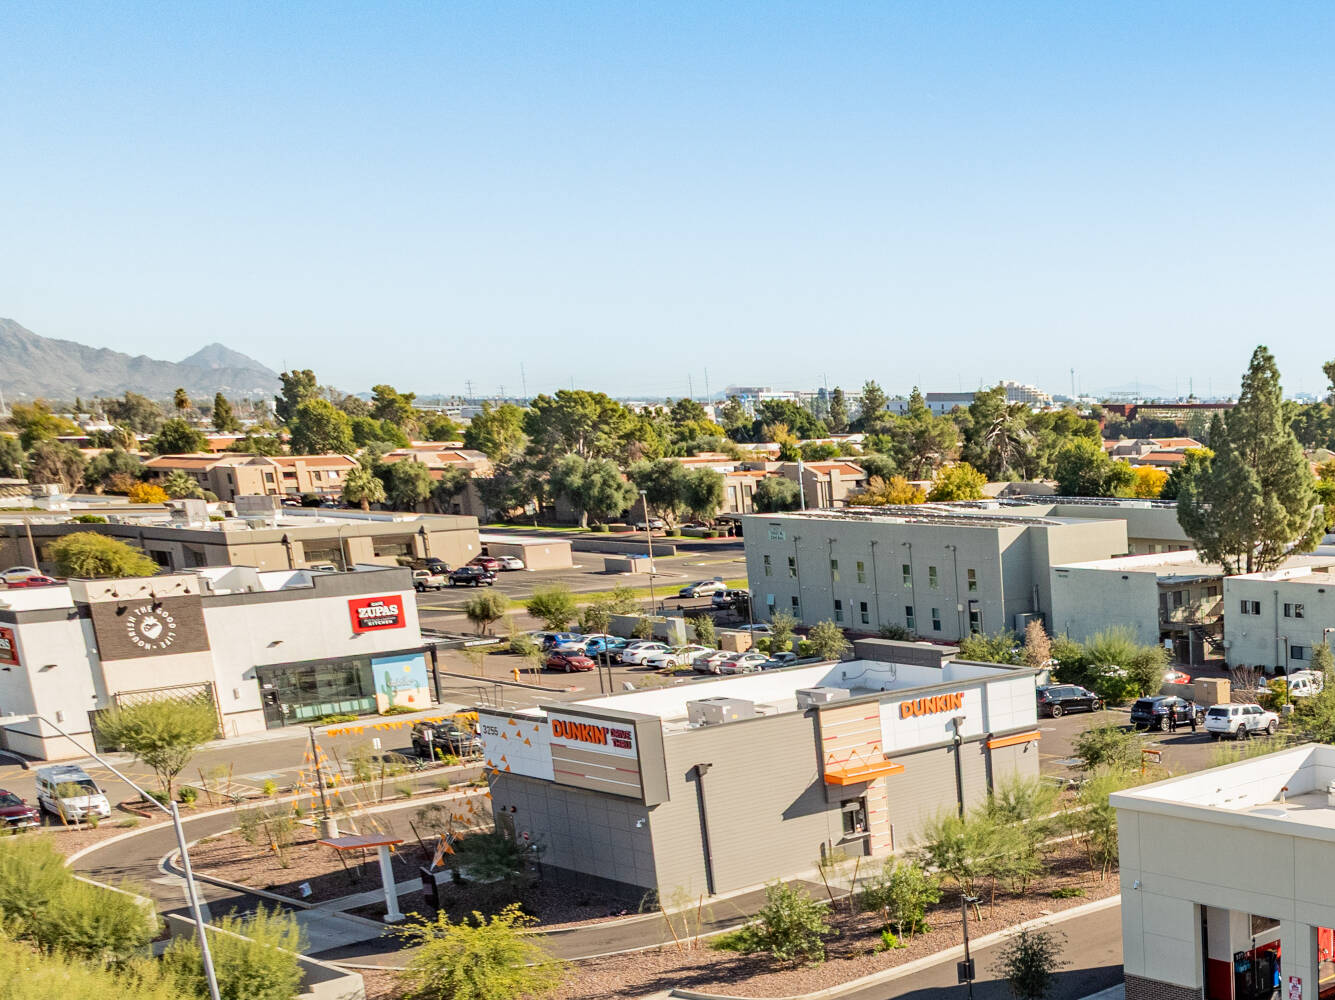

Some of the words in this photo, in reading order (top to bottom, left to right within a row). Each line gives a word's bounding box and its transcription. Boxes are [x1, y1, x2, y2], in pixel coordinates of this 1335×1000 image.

[134, 605, 153, 615] THE
[156, 607, 176, 629] GOOD
[357, 604, 399, 618] ZUPAS
[126, 616, 151, 650] NOURISH
[160, 632, 176, 649] LIFE
[900, 692, 964, 720] DUNKIN'
[552, 719, 609, 746] DUNKIN'
